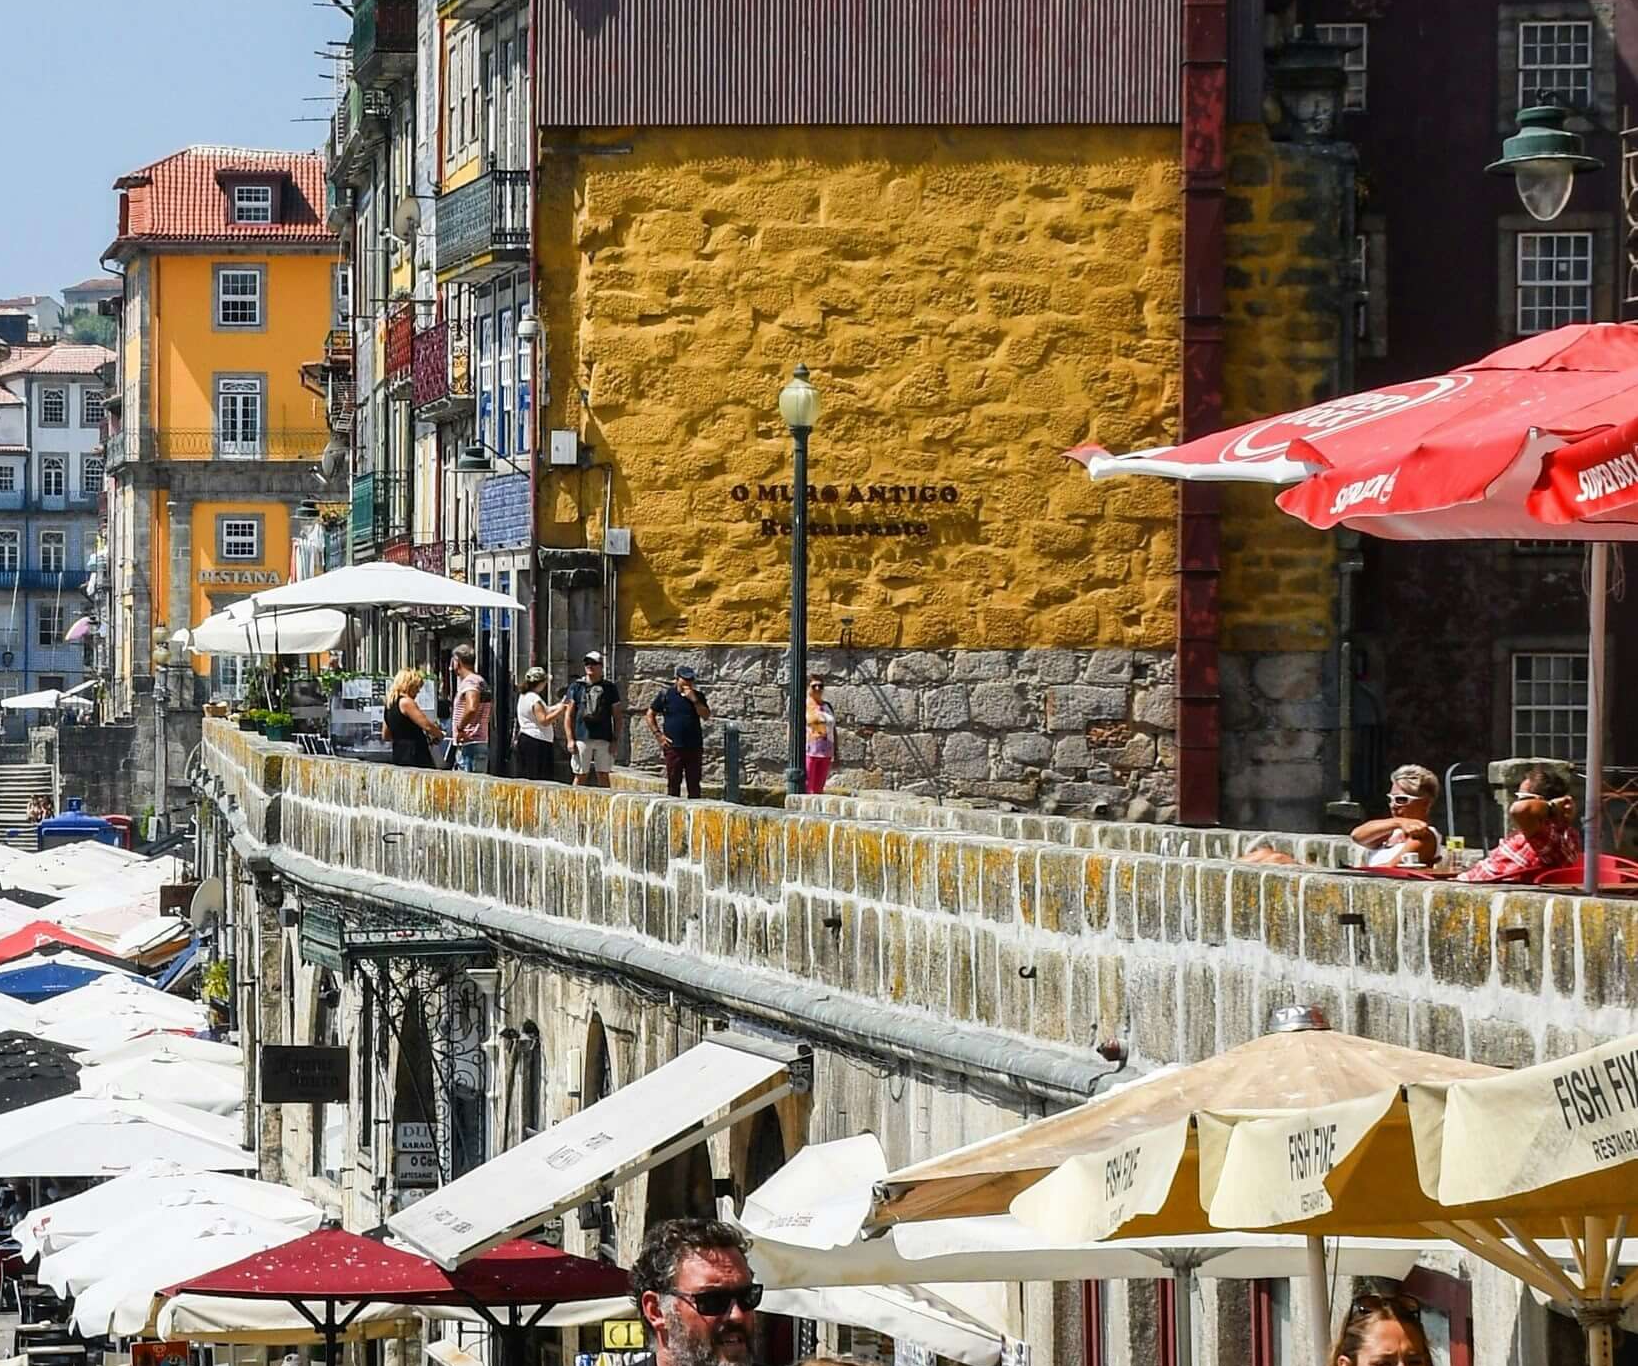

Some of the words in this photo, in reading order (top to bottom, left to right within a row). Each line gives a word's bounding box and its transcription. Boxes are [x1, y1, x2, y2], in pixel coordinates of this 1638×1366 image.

[730, 485, 750, 503] O
[846, 484, 959, 504] ANTIGO
[762, 518, 930, 537] Retaurante
[197, 569, 281, 586] PESTANA
[1553, 1065, 1612, 1130] FISH
[1603, 1049, 1638, 1113] FIX
[402, 1141, 433, 1150] KARAO
[1288, 1130, 1312, 1182] FISH
[1313, 1123, 1338, 1179] FIXE
